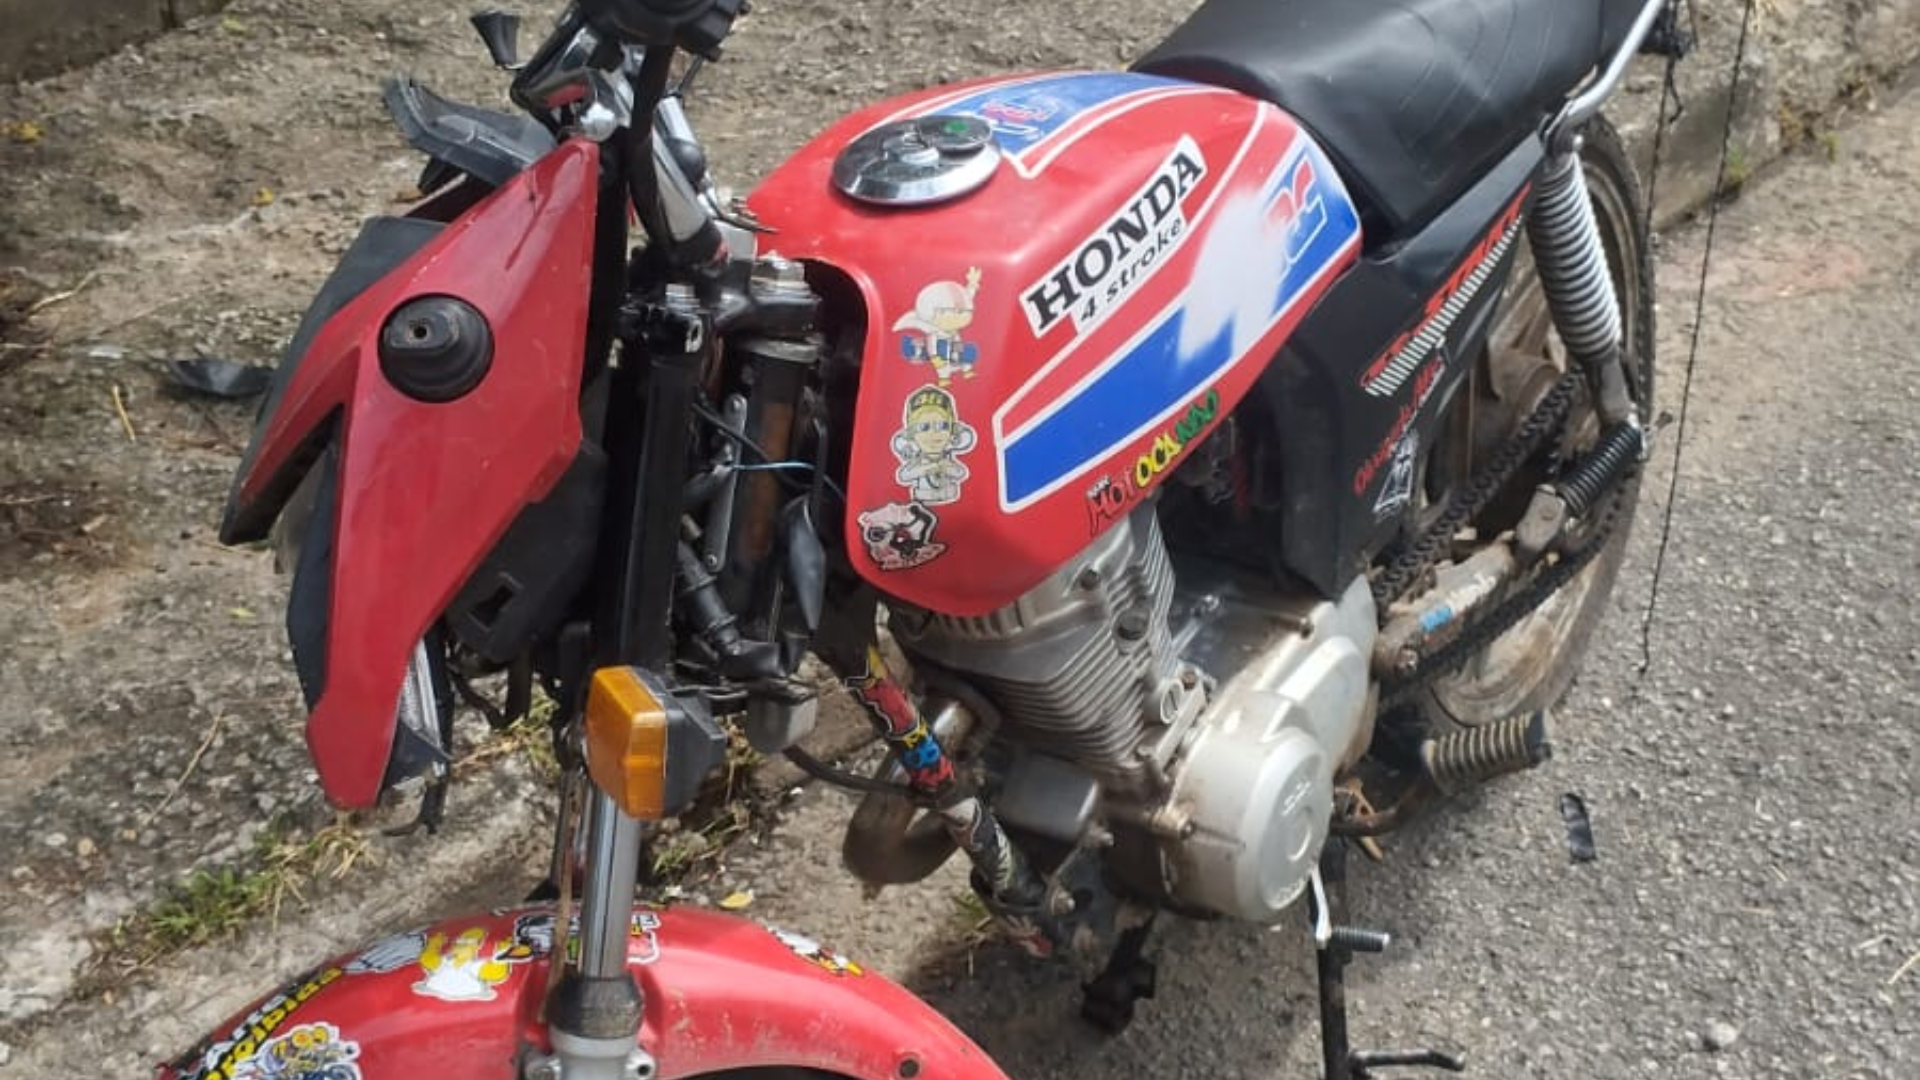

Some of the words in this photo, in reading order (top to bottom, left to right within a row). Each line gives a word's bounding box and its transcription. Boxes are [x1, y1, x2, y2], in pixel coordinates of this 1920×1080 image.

[1026, 152, 1203, 331] HONDA
[1080, 296, 1097, 322] 4
[1105, 218, 1182, 303] stroke
